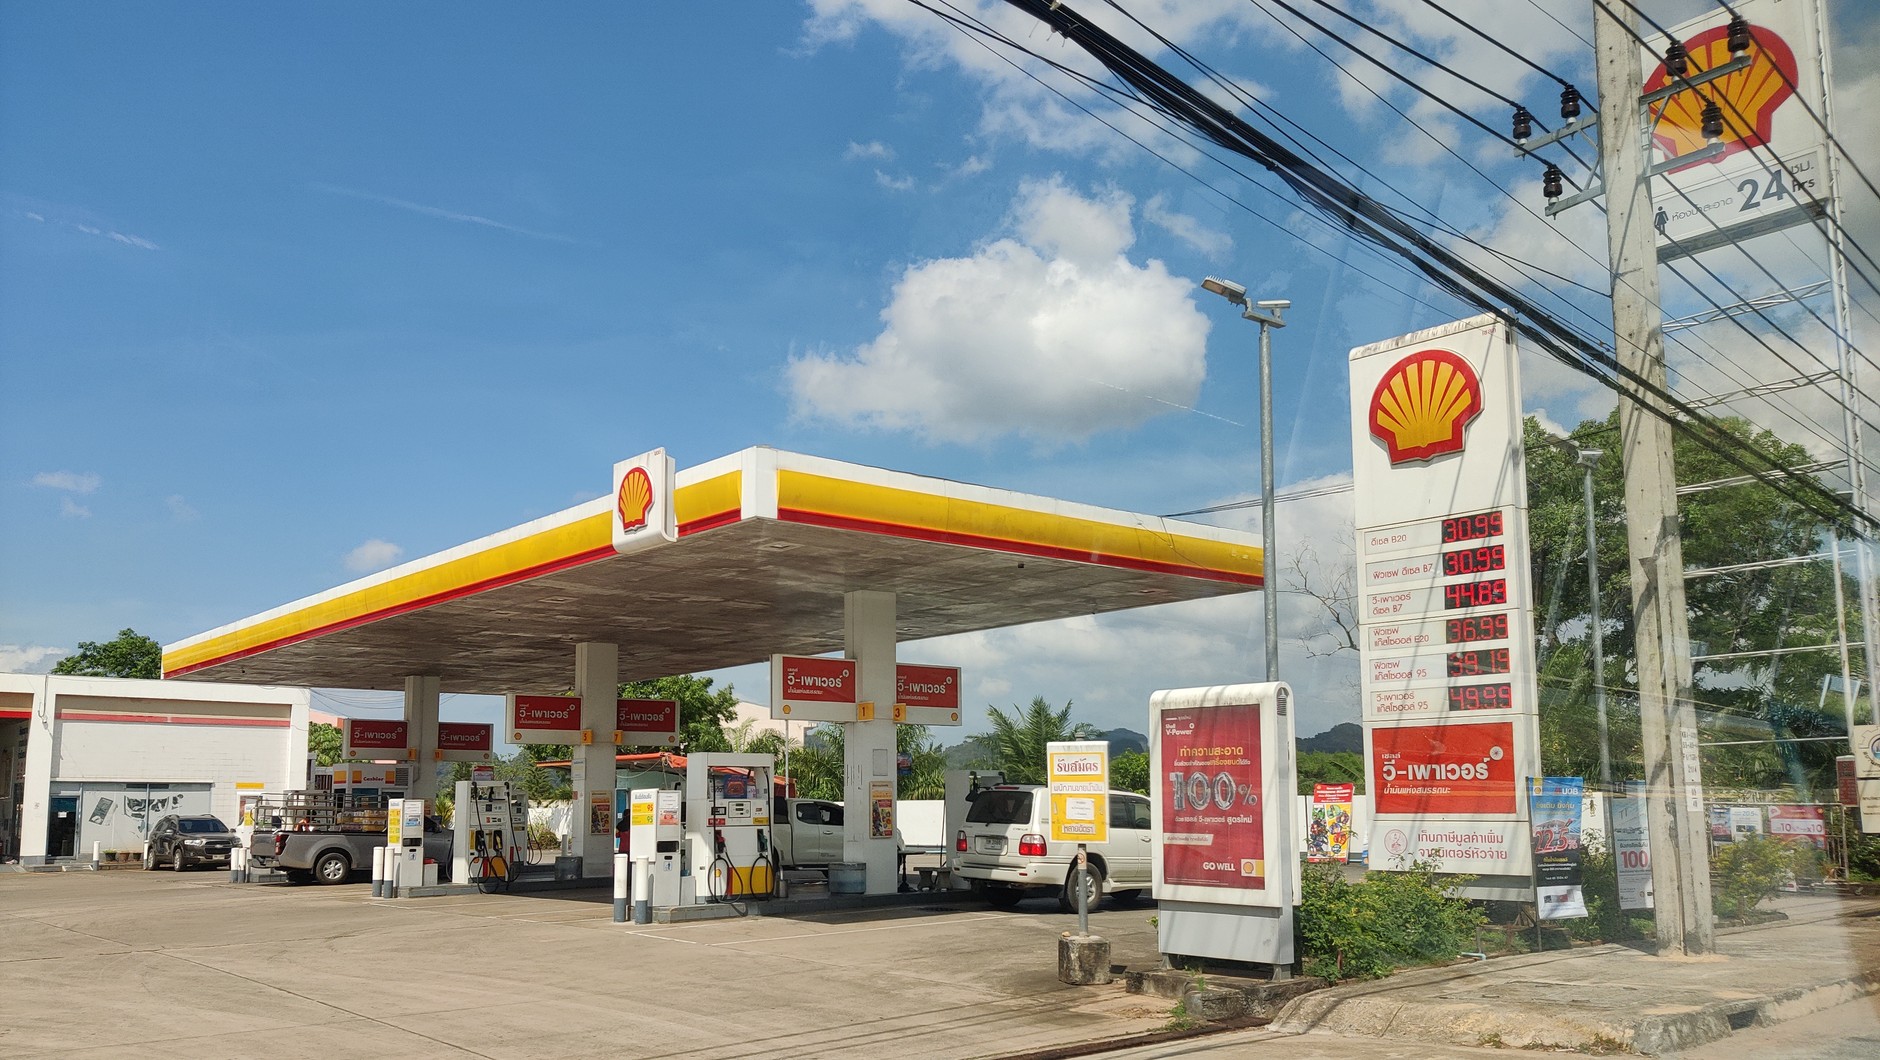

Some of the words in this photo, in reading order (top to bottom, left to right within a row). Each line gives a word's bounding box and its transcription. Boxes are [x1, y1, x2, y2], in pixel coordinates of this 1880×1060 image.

[1737, 169, 1788, 212] 24
[1370, 536, 1389, 546] ดีเซล
[1392, 534, 1407, 544] B20
[1443, 511, 1503, 543] 30.99
[1402, 566, 1420, 576] ดีเซล
[1423, 563, 1433, 573] B7
[1445, 545, 1505, 576] 30.99
[1372, 592, 1412, 604] วี-เพาเวอร์
[1446, 579, 1507, 608] 44.89
[1372, 606, 1390, 615] ดีเซล
[1392, 604, 1403, 613] B7
[1448, 615, 1508, 642] 36.99
[1414, 635, 1429, 644] E20
[1450, 650, 1510, 677] 39.19
[787, 672, 842, 688] วี-เพาเวอร์
[1416, 669, 1427, 678] 95
[897, 679, 946, 694] วี-เพาเวอร์
[1376, 692, 1415, 702] วี-เพาเวอร์
[1450, 685, 1511, 710] 49.99
[862, 706, 866, 716] 1
[895, 708, 900, 718] 3
[1418, 701, 1428, 710] 95
[519, 707, 570, 720] วี-เพาเวอร์
[619, 710, 665, 722] วี-เพาเวอร์
[1180, 746, 1244, 756] ทำความสะอาด
[1056, 758, 1098, 772] รับสมัคร
[1382, 757, 1490, 781] วี-เพาเวอร์
[1169, 771, 1258, 811] 100%
[1384, 783, 1450, 794] น้ำมันแห่งสมรรถนะ
[1227, 814, 1252, 825] สูตรใหม่
[1418, 829, 1504, 846] เก็บภาษีมูลค่าเพิ่ม
[1535, 828, 1578, 854] 22.5%
[1203, 862, 1216, 870] GO
[1217, 863, 1236, 871] WELL
[1621, 850, 1648, 868] 100
